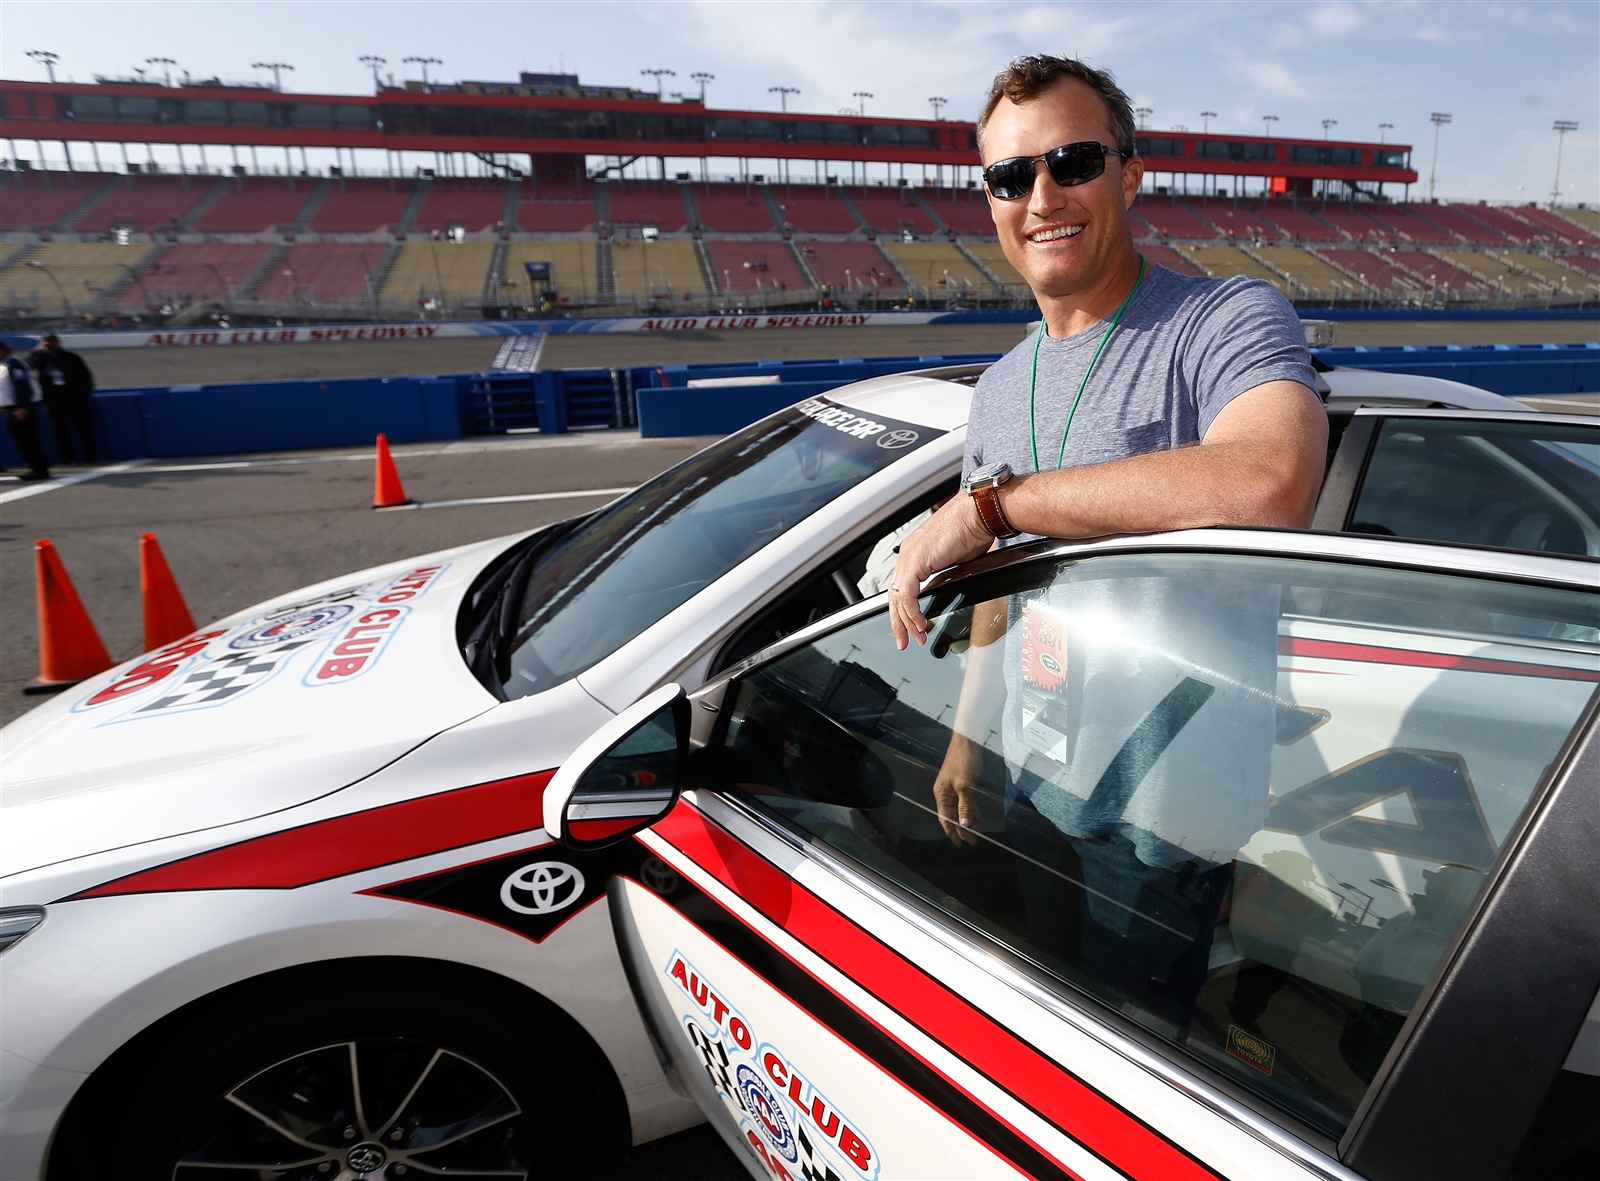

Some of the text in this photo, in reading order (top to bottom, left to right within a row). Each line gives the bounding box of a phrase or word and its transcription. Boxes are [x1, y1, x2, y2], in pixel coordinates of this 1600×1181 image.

[147, 324, 440, 346] AUTO CLUB SPEEDWAY
[639, 313, 872, 331] AUTO CLUB SPEEDWAY
[810, 406, 854, 427] PACE
[835, 417, 887, 439] CAR
[317, 565, 442, 680] AUTO CLUB
[671, 958, 752, 1051] AUTO
[764, 1052, 871, 1172] CLUB
[1236, 1046, 1263, 1066] TOYOTA
[752, 1093, 780, 1132] AAA
